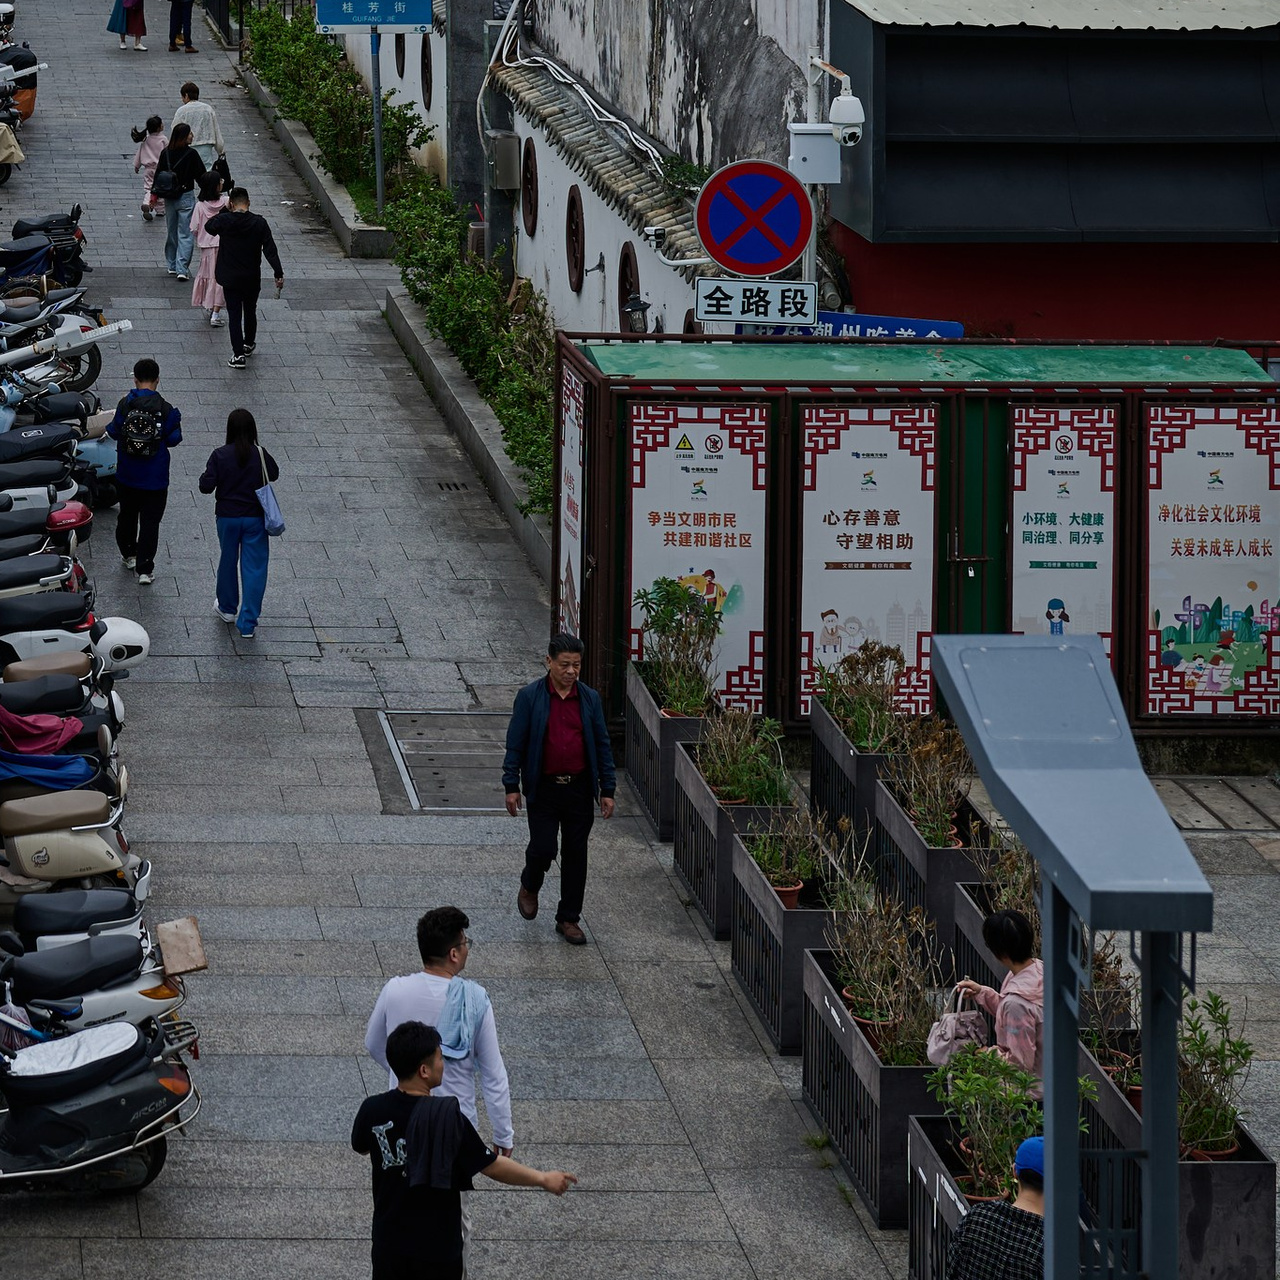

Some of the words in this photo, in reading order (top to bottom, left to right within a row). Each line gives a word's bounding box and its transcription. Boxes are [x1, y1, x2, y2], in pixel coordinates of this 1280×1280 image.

[342, 1, 406, 14] 桂芳街
[703, 286, 809, 318] 全路段
[647, 511, 737, 528] 争当文明市民
[822, 508, 901, 526] 心存善意
[1022, 512, 1104, 526] 小环境、大健康
[1158, 503, 1261, 523] 净化社会文化环境
[663, 531, 752, 548] 共建和谐社区
[836, 533, 914, 550] 守望相助
[1022, 530, 1104, 545] 同治理、同分享
[1170, 537, 1273, 557] 关爱未成年人成长
